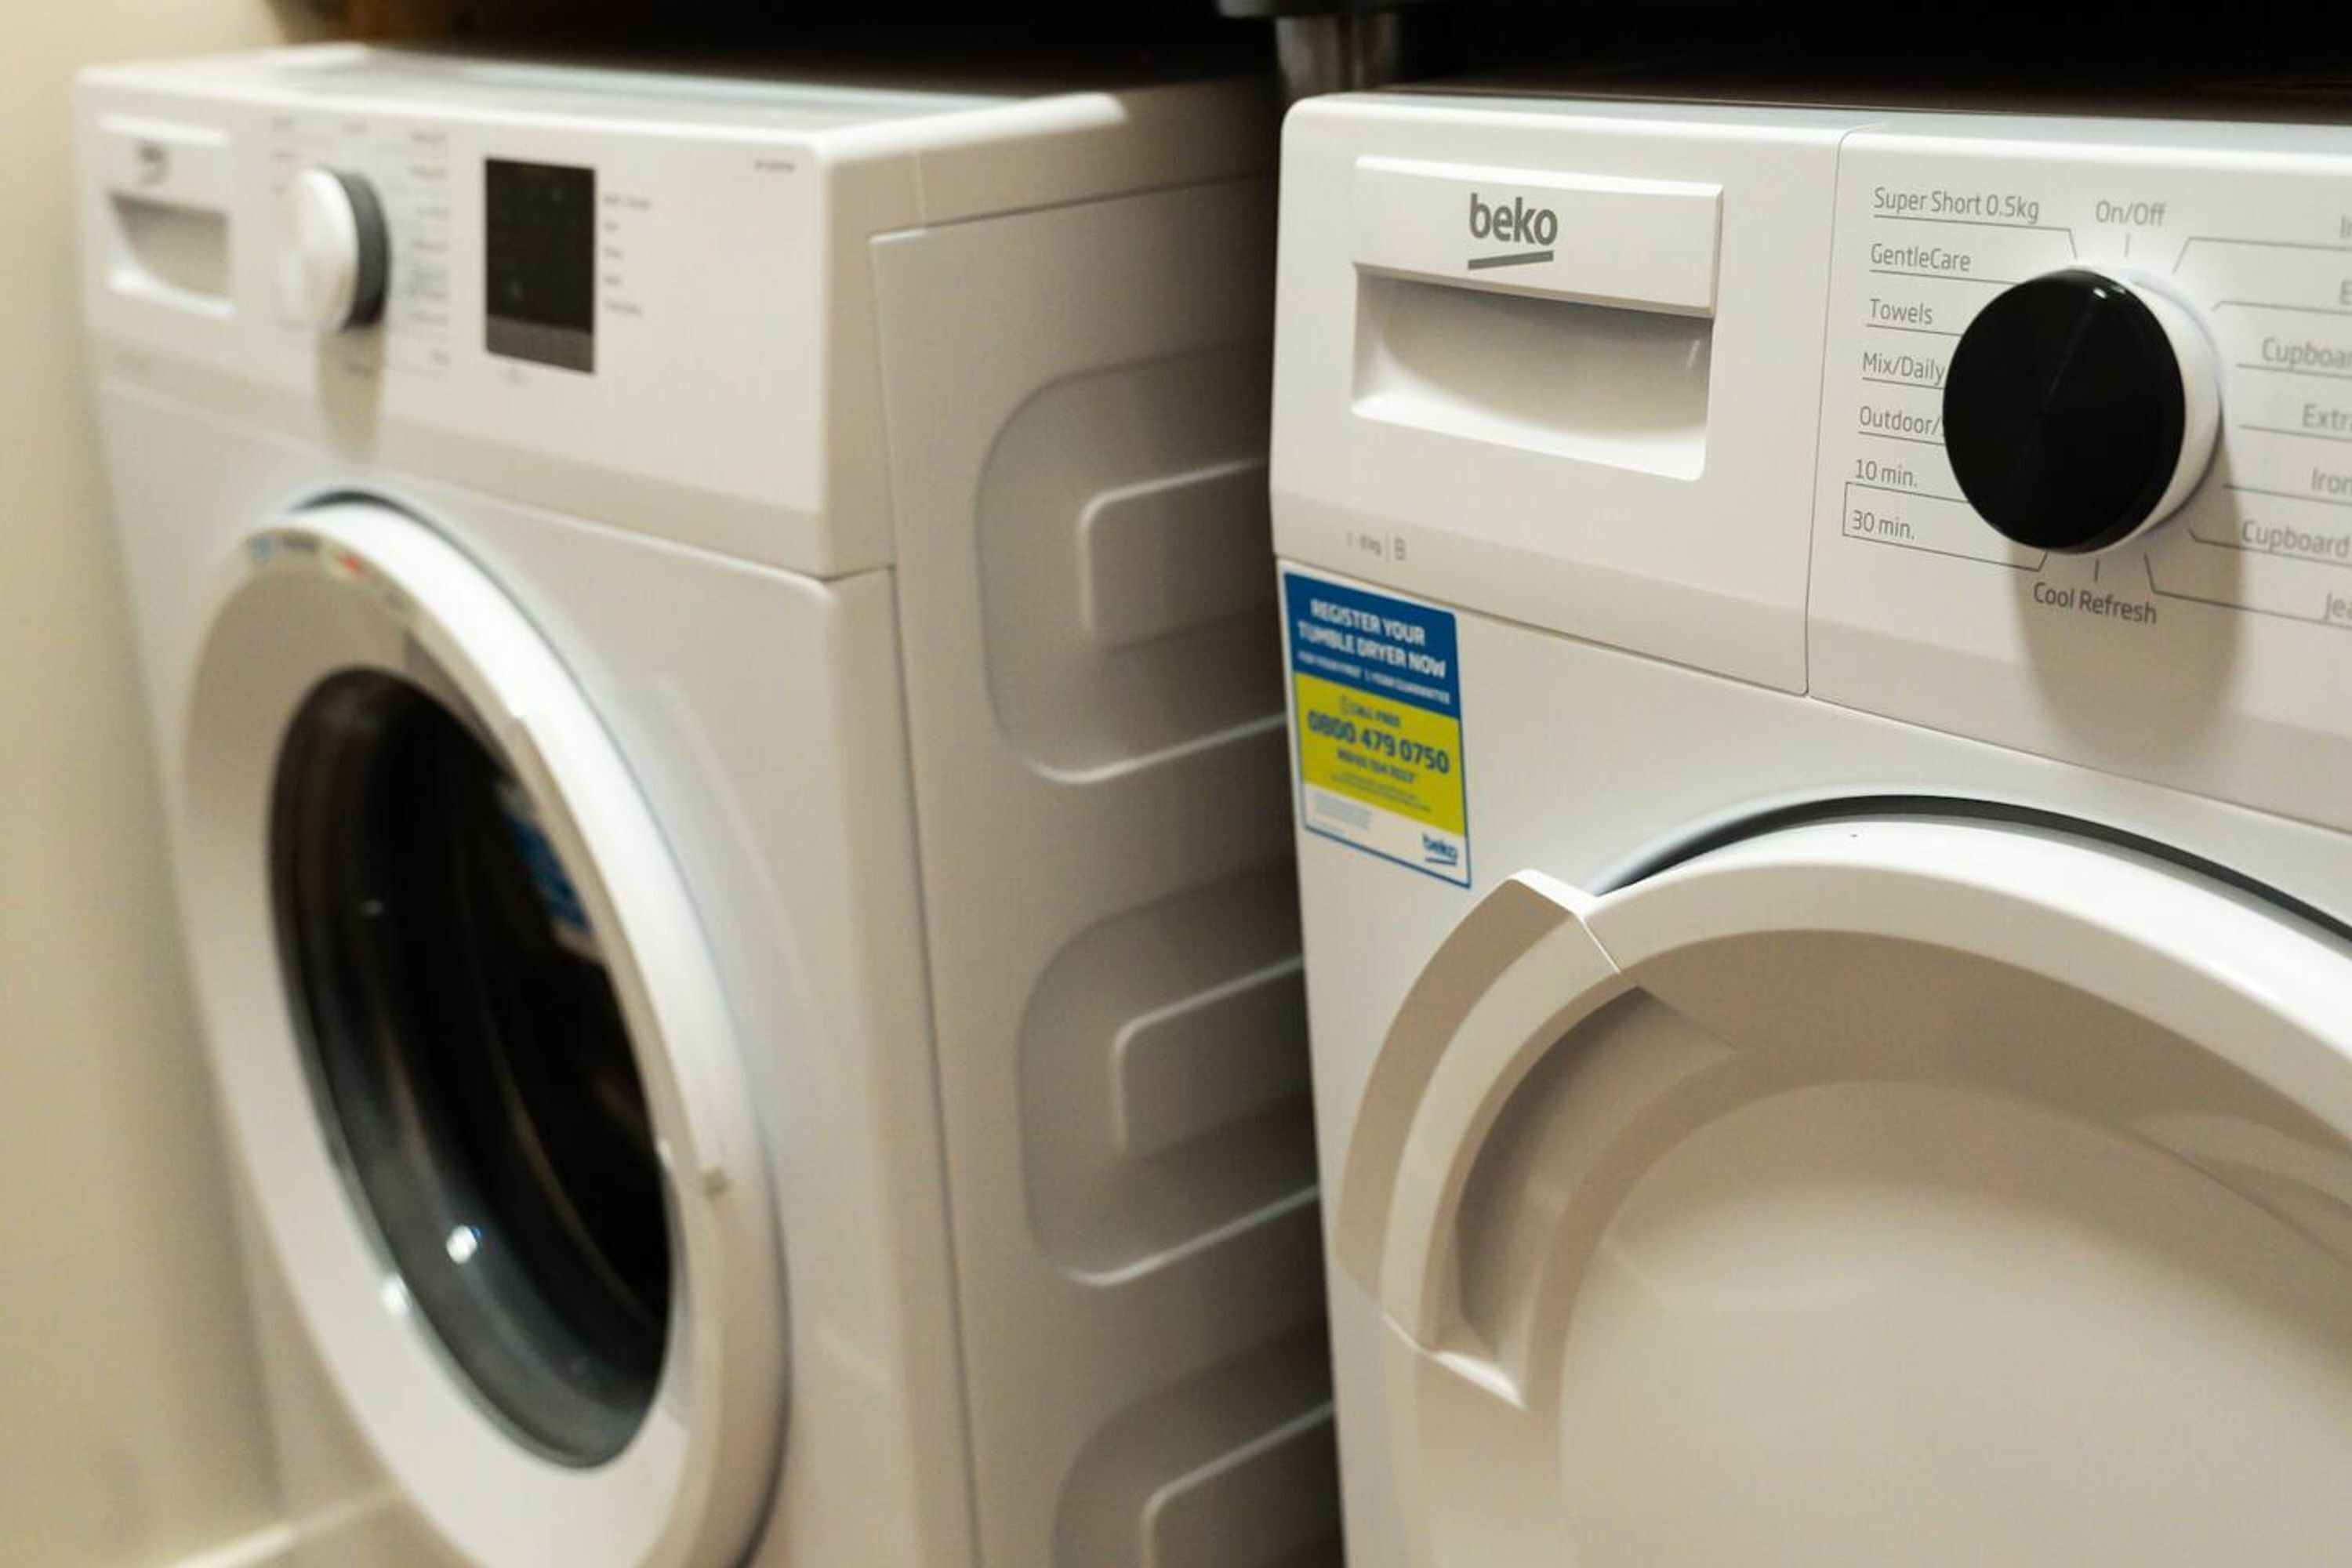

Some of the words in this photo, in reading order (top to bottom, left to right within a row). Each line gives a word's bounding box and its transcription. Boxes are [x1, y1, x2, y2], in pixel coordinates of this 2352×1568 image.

[1469, 192, 1558, 246] beko
[1874, 186, 1927, 214] Super
[1930, 191, 1982, 215] Short
[1985, 194, 2040, 223] 0.5kg
[2095, 200, 2166, 225] On/Off
[1870, 242, 1971, 272] GentleCare
[1869, 298, 1933, 325] Towels
[1862, 352, 1946, 386] Mix/Daily
[1859, 405, 1941, 436] Outdoor/
[2303, 403, 2352, 432] Extr
[1855, 458, 1878, 481] 10
[1881, 464, 1918, 488] min.
[1852, 510, 1875, 533] 30
[1878, 516, 1915, 540] min.
[2241, 519, 2350, 558] Cupboard
[2034, 581, 2075, 610] Cool
[2079, 590, 2157, 624] Refresh
[1310, 598, 1381, 635] REGISTER
[1382, 617, 1425, 647] YOUR
[1298, 619, 1356, 654] TUMBLE
[1356, 637, 1407, 668] DRYER
[1408, 651, 1446, 678] NOW
[1308, 709, 1356, 744] 0800
[1360, 728, 1396, 757] 479
[1399, 739, 1450, 775] 0750
